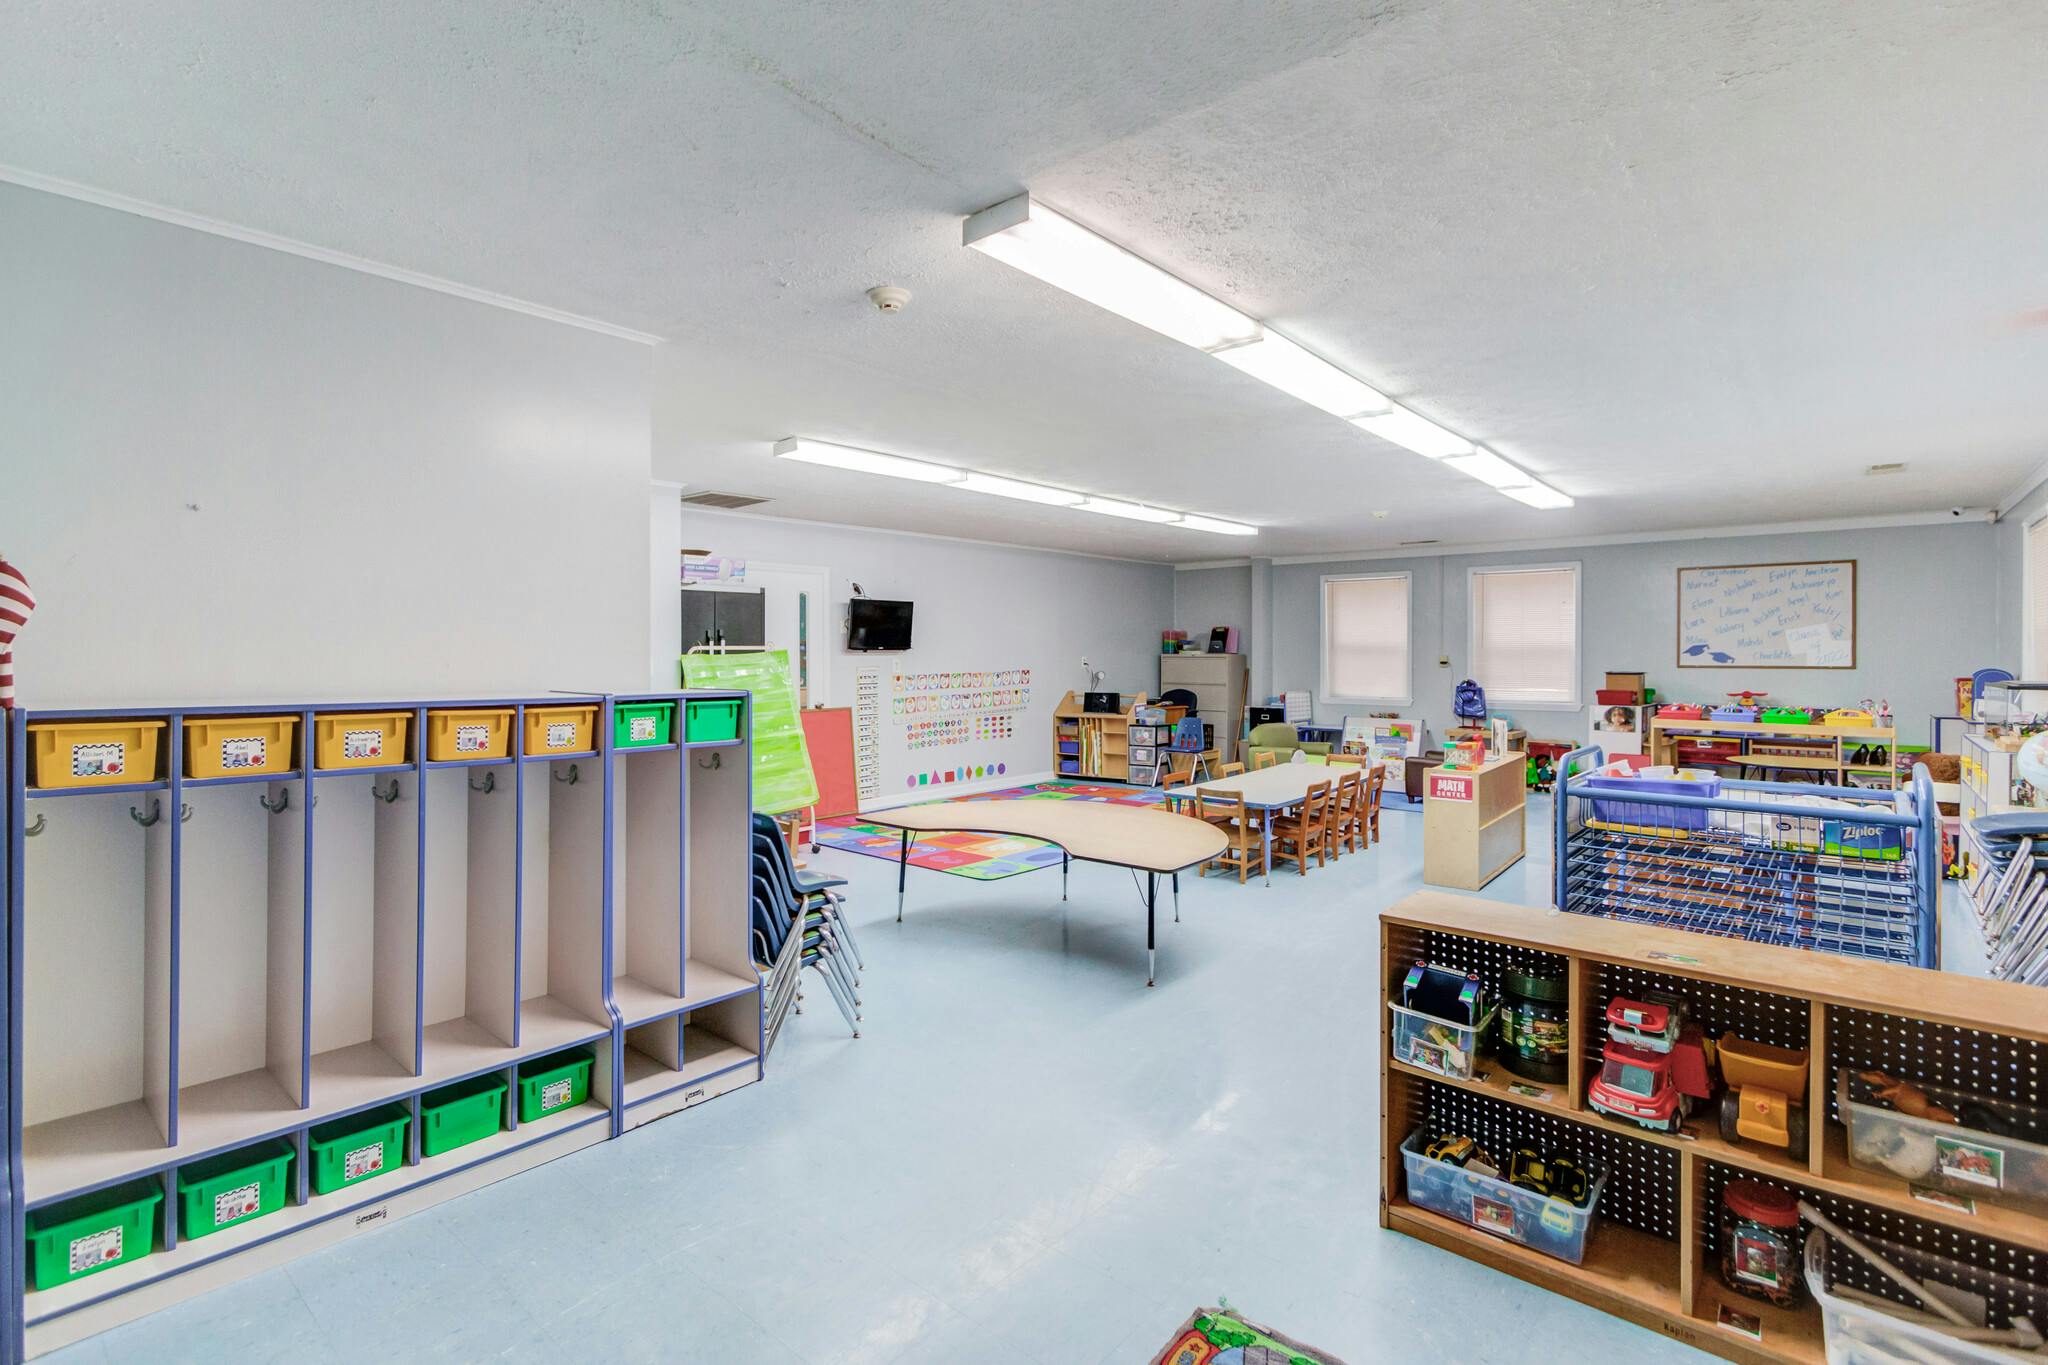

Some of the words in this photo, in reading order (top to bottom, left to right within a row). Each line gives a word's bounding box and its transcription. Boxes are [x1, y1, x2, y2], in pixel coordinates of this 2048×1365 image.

[1437, 779, 1465, 792] MATH
[1436, 790, 1467, 799] CENTER
[1842, 826, 1883, 840] Ziploc
